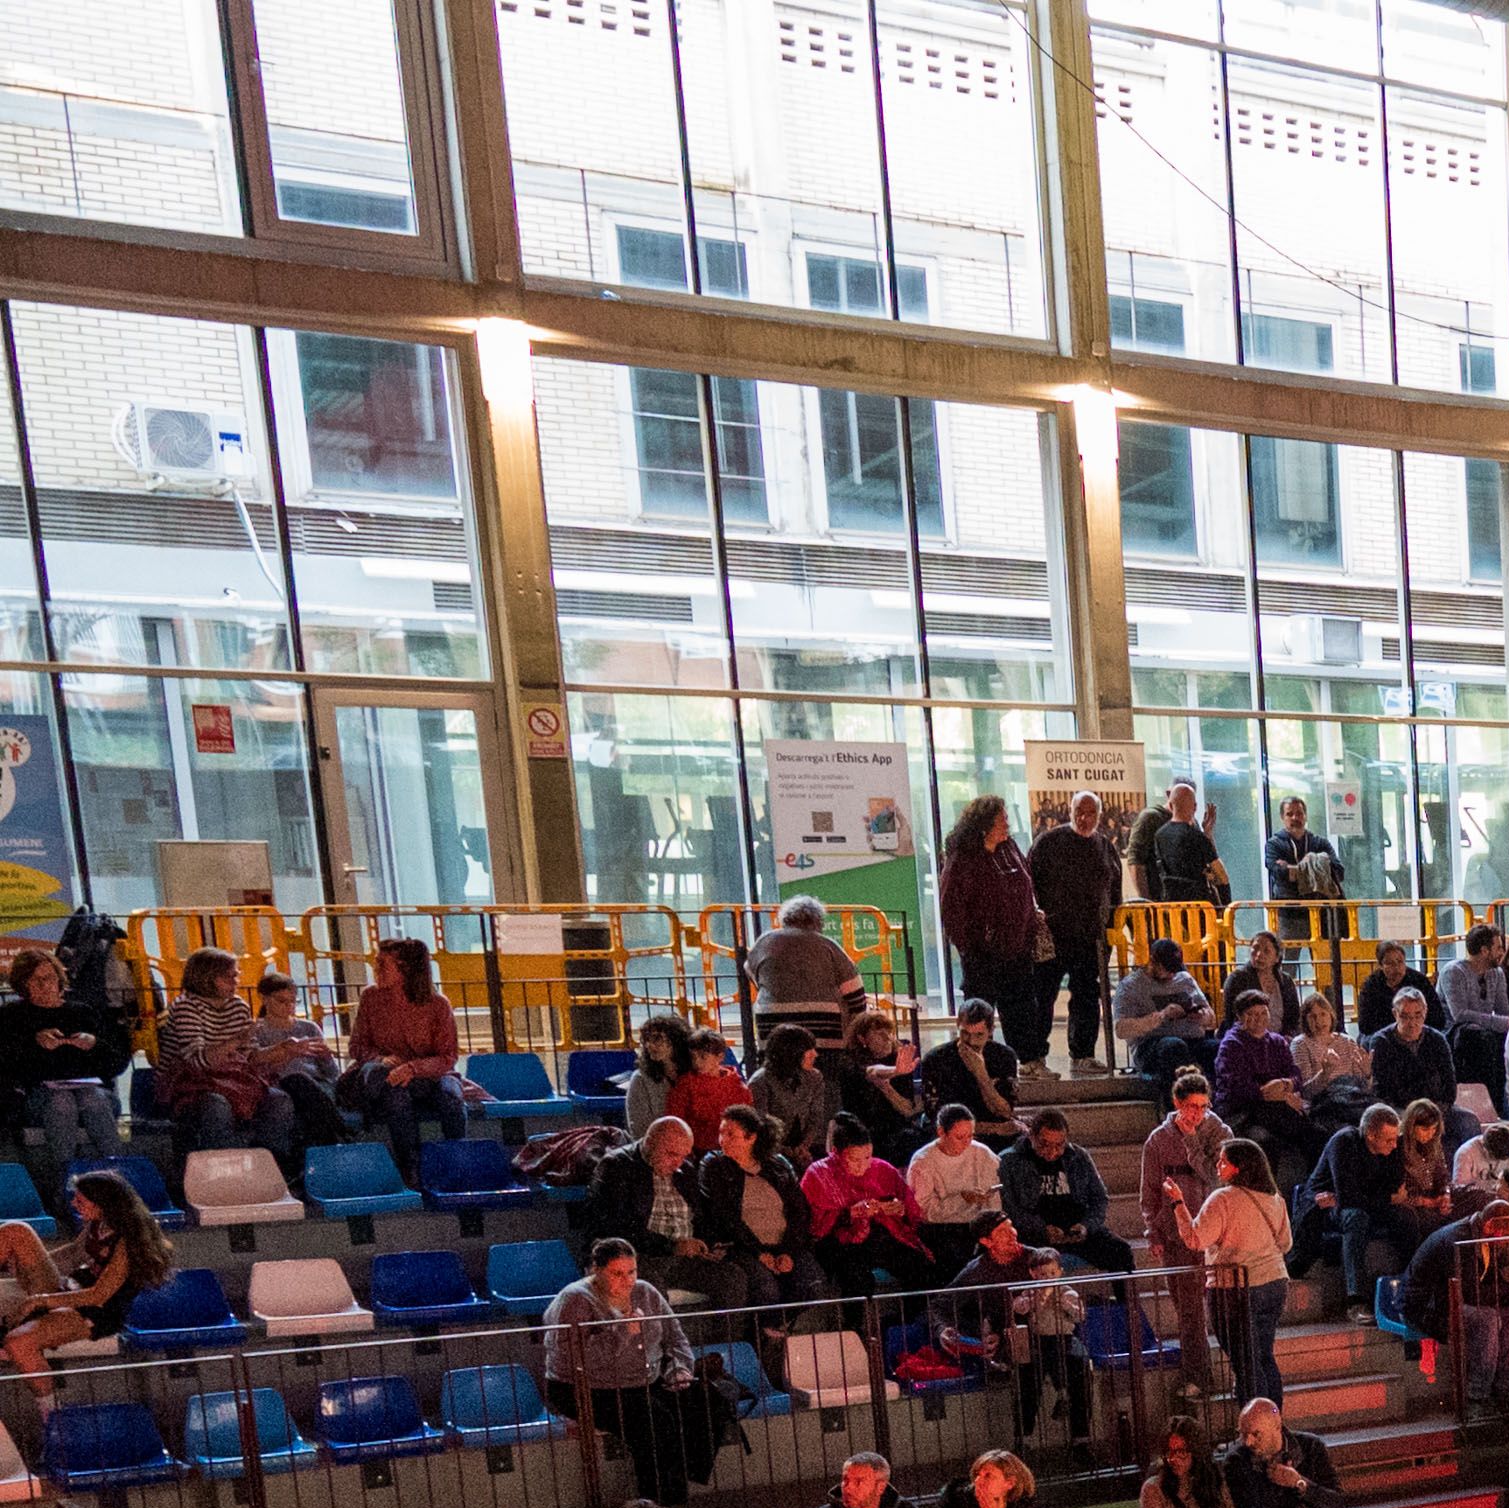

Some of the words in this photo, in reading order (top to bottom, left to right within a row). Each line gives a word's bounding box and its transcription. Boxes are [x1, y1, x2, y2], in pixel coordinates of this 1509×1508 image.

[872, 754, 892, 766] App
[1045, 751, 1125, 765] ORTODONCIA
[1047, 768, 1080, 781] SANT
[1084, 769, 1126, 782] CUGAT
